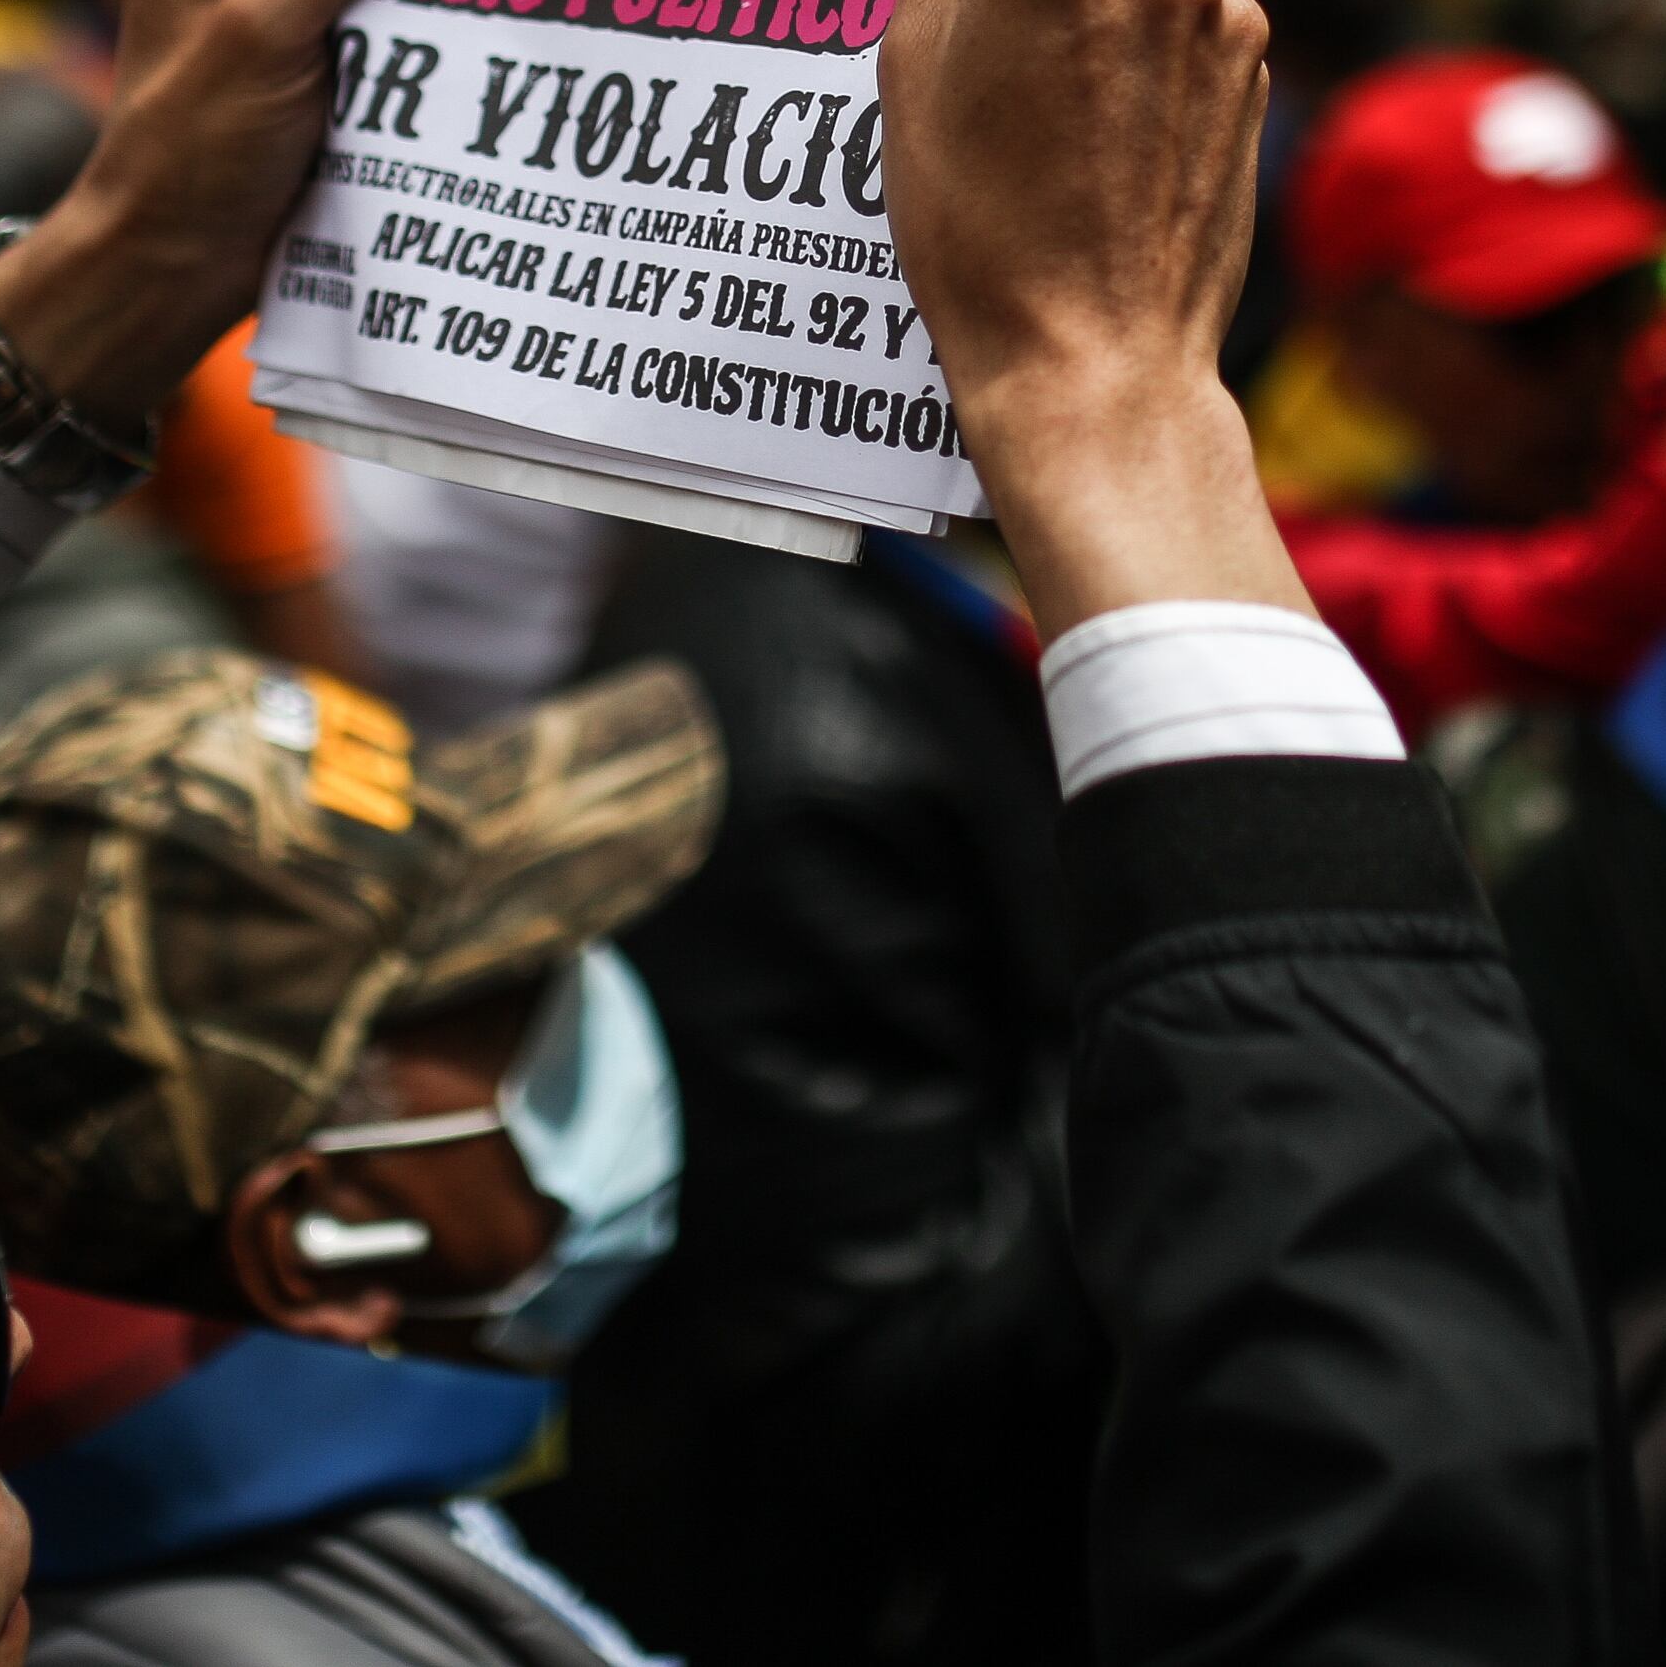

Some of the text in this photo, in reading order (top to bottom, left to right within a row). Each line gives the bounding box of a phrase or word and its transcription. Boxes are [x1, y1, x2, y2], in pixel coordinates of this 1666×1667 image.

[359, 154, 575, 227] ELECTRORALES
[576, 201, 616, 236] EN
[619, 207, 745, 255] CAMPAÑA
[370, 213, 545, 291] APLICAR
[548, 251, 603, 307] LA
[606, 260, 680, 317] LEY
[679, 270, 710, 321] 5
[711, 274, 795, 338] DEL
[807, 291, 870, 351] 92
[884, 304, 919, 360] Y
[359, 289, 428, 344] ART.
[435, 306, 511, 361] 109
[511, 325, 576, 379] DE
[574, 337, 627, 395] LA
